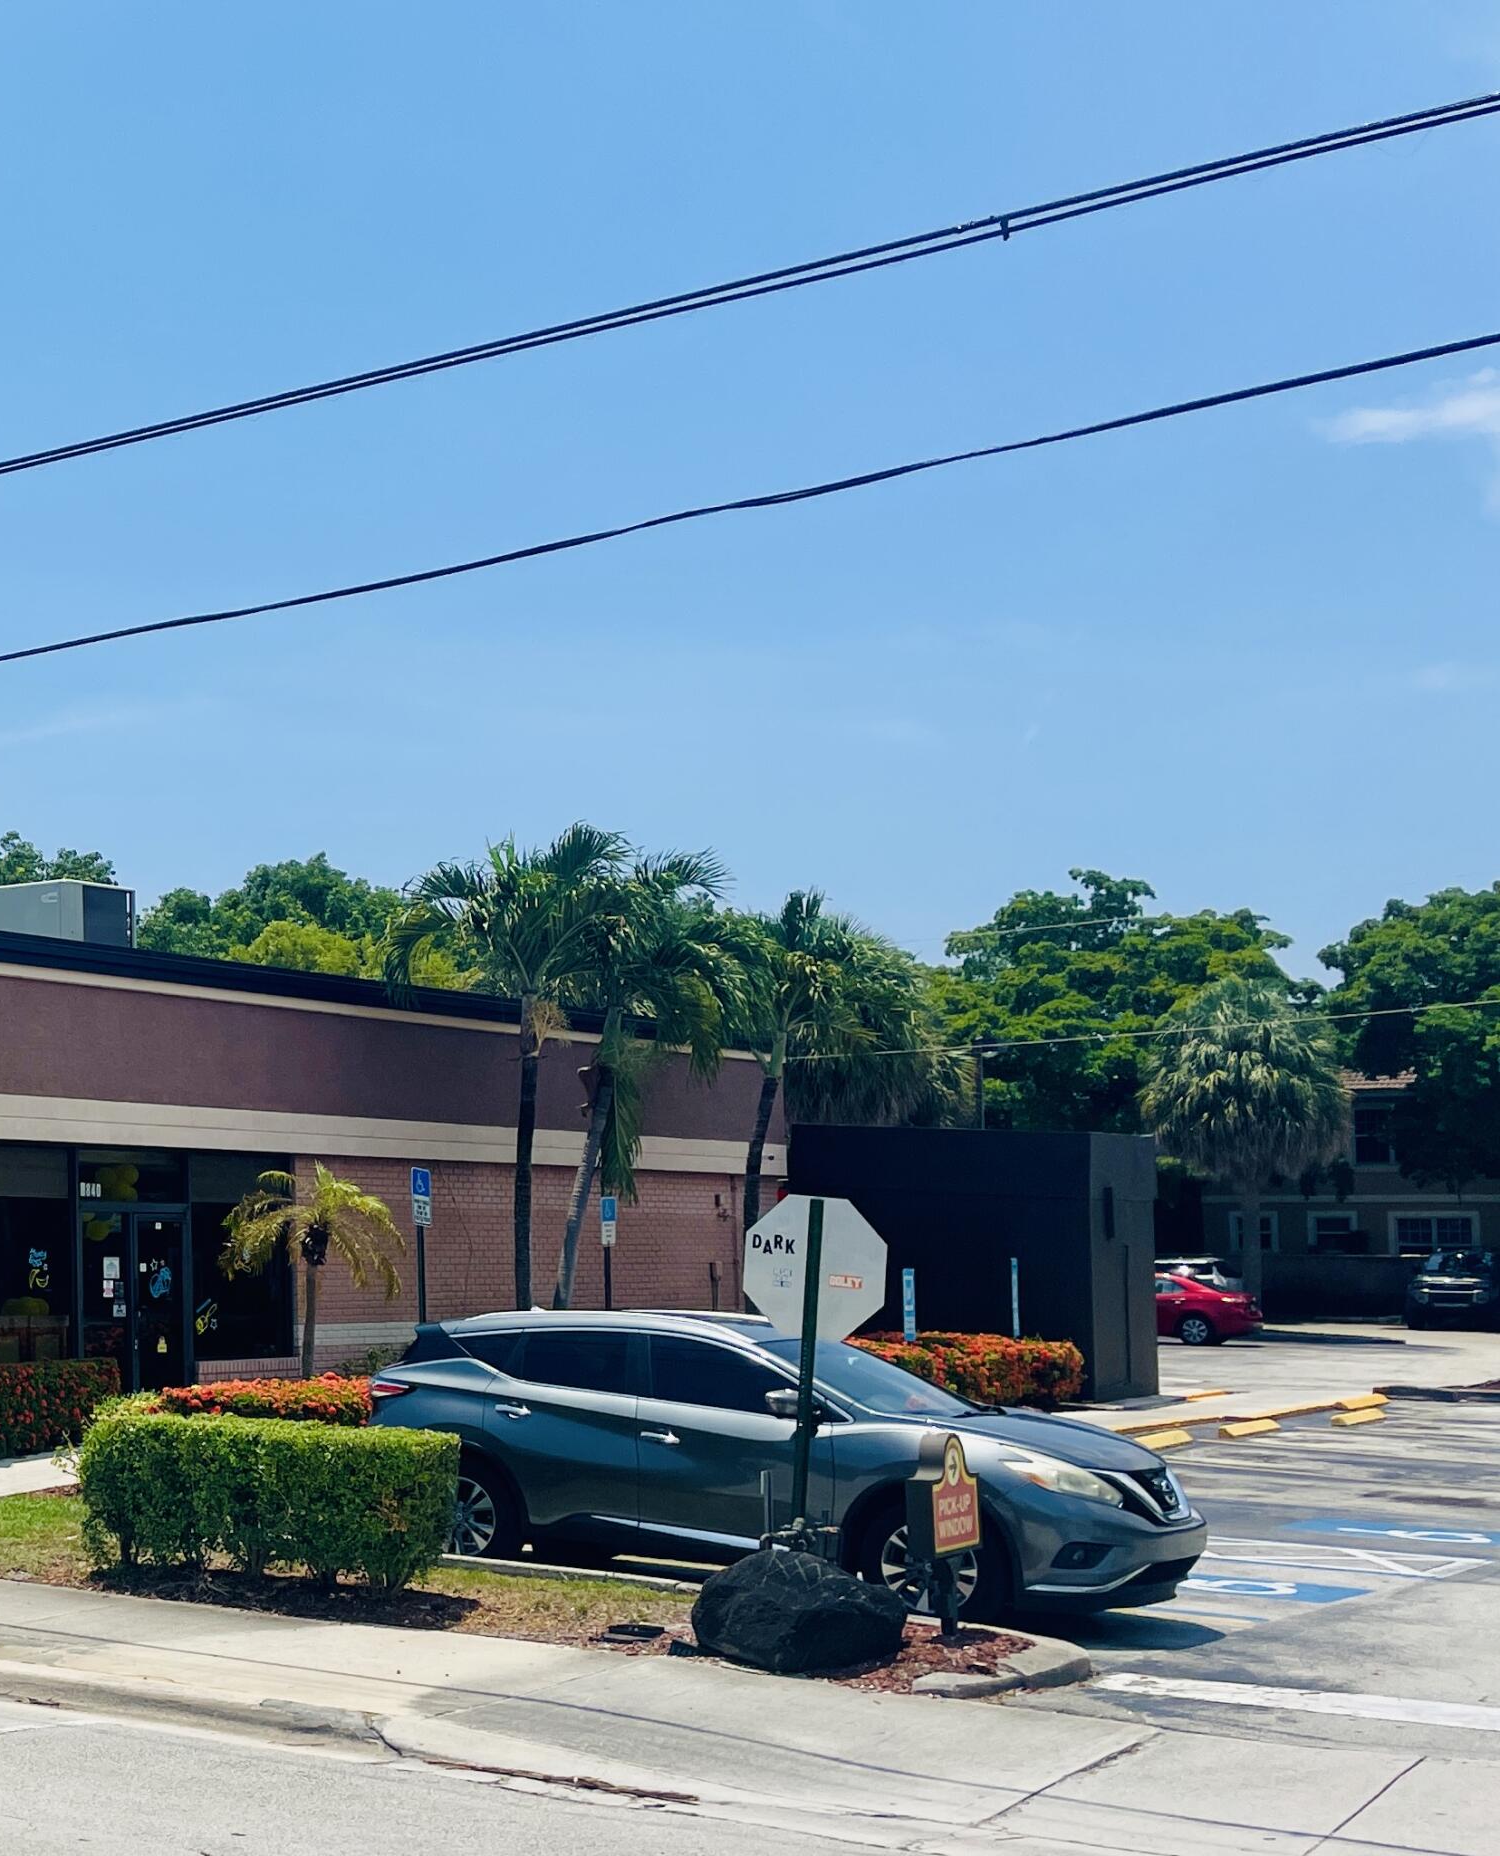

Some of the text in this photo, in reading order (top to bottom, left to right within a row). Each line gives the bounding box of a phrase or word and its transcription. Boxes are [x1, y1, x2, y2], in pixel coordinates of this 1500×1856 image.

[752, 1234, 795, 1255] DARK
[938, 1493, 972, 1516] PICK-UP
[939, 1515, 973, 1538] WINDOW
